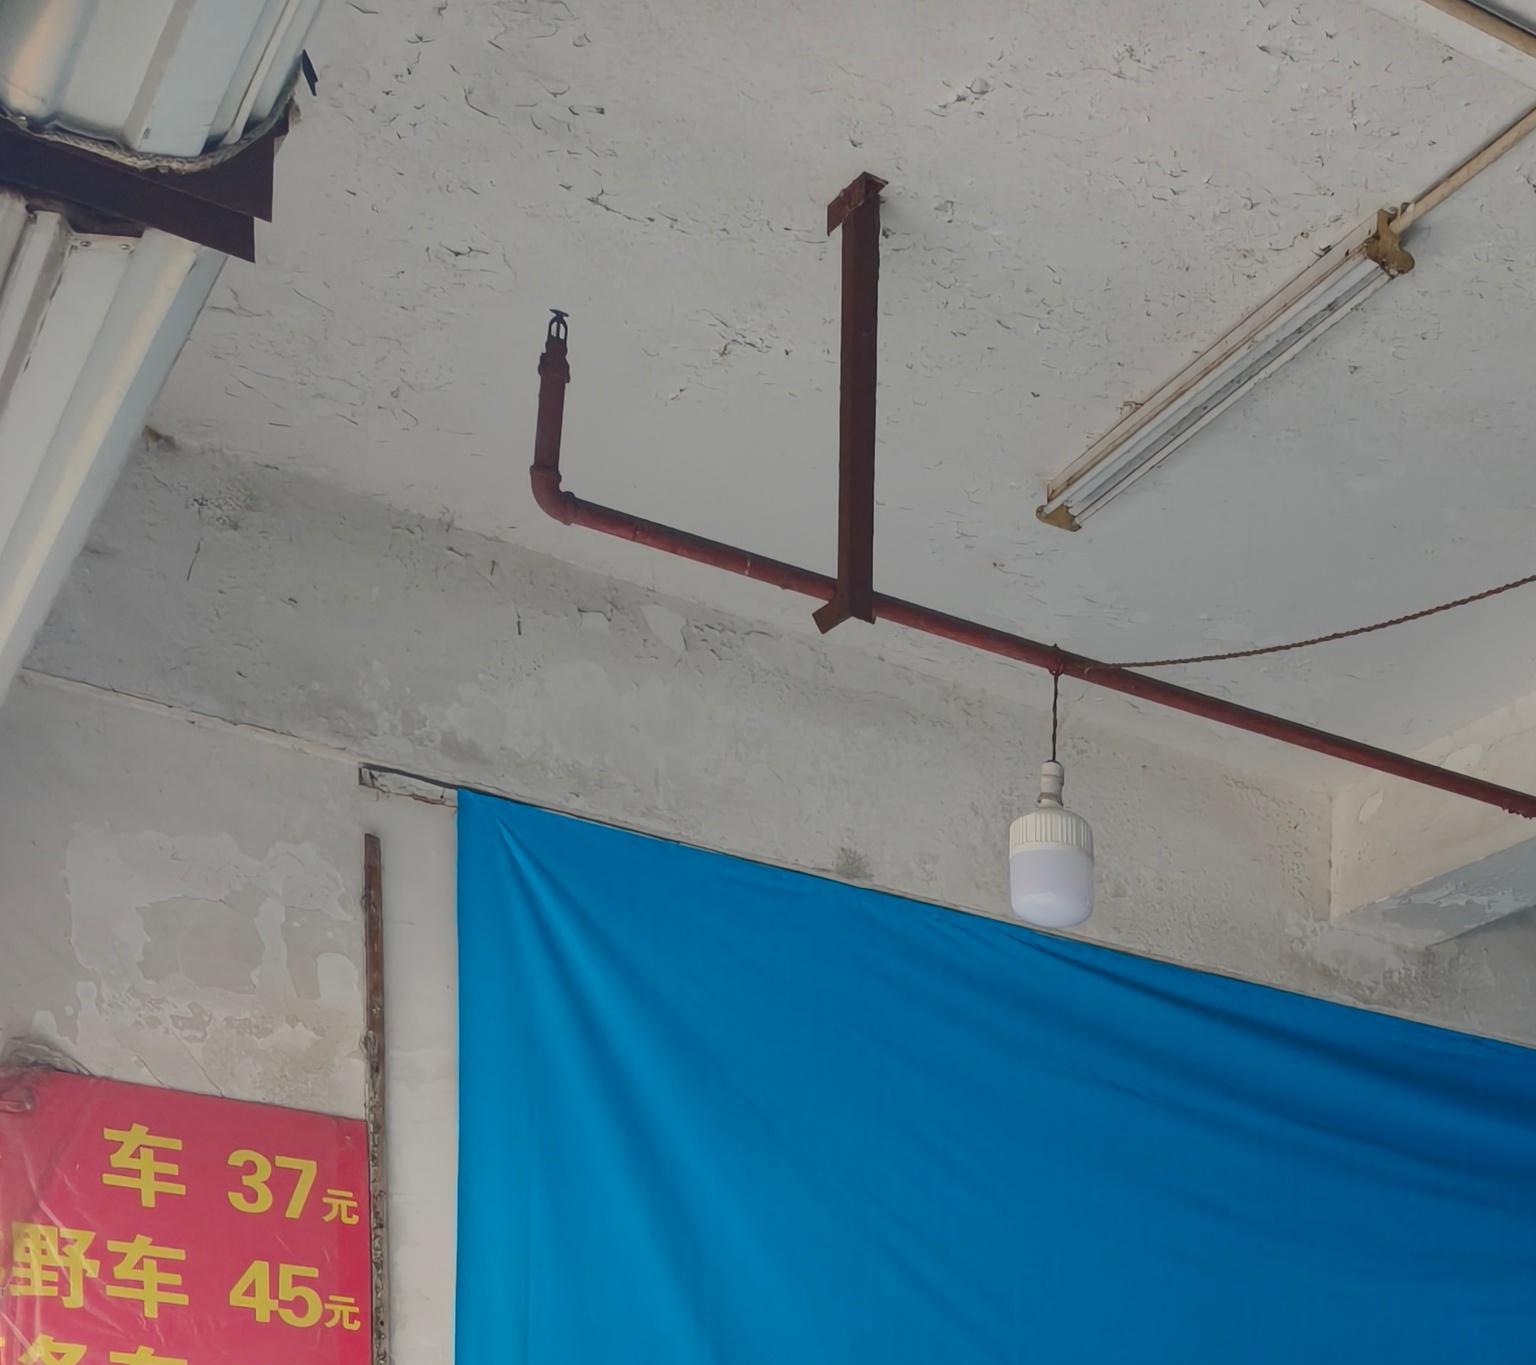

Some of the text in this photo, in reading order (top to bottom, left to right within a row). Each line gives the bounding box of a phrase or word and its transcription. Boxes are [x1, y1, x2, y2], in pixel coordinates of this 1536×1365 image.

[102, 1122, 360, 1226] 车 37元
[0, 1220, 361, 1332] 野车 45元
